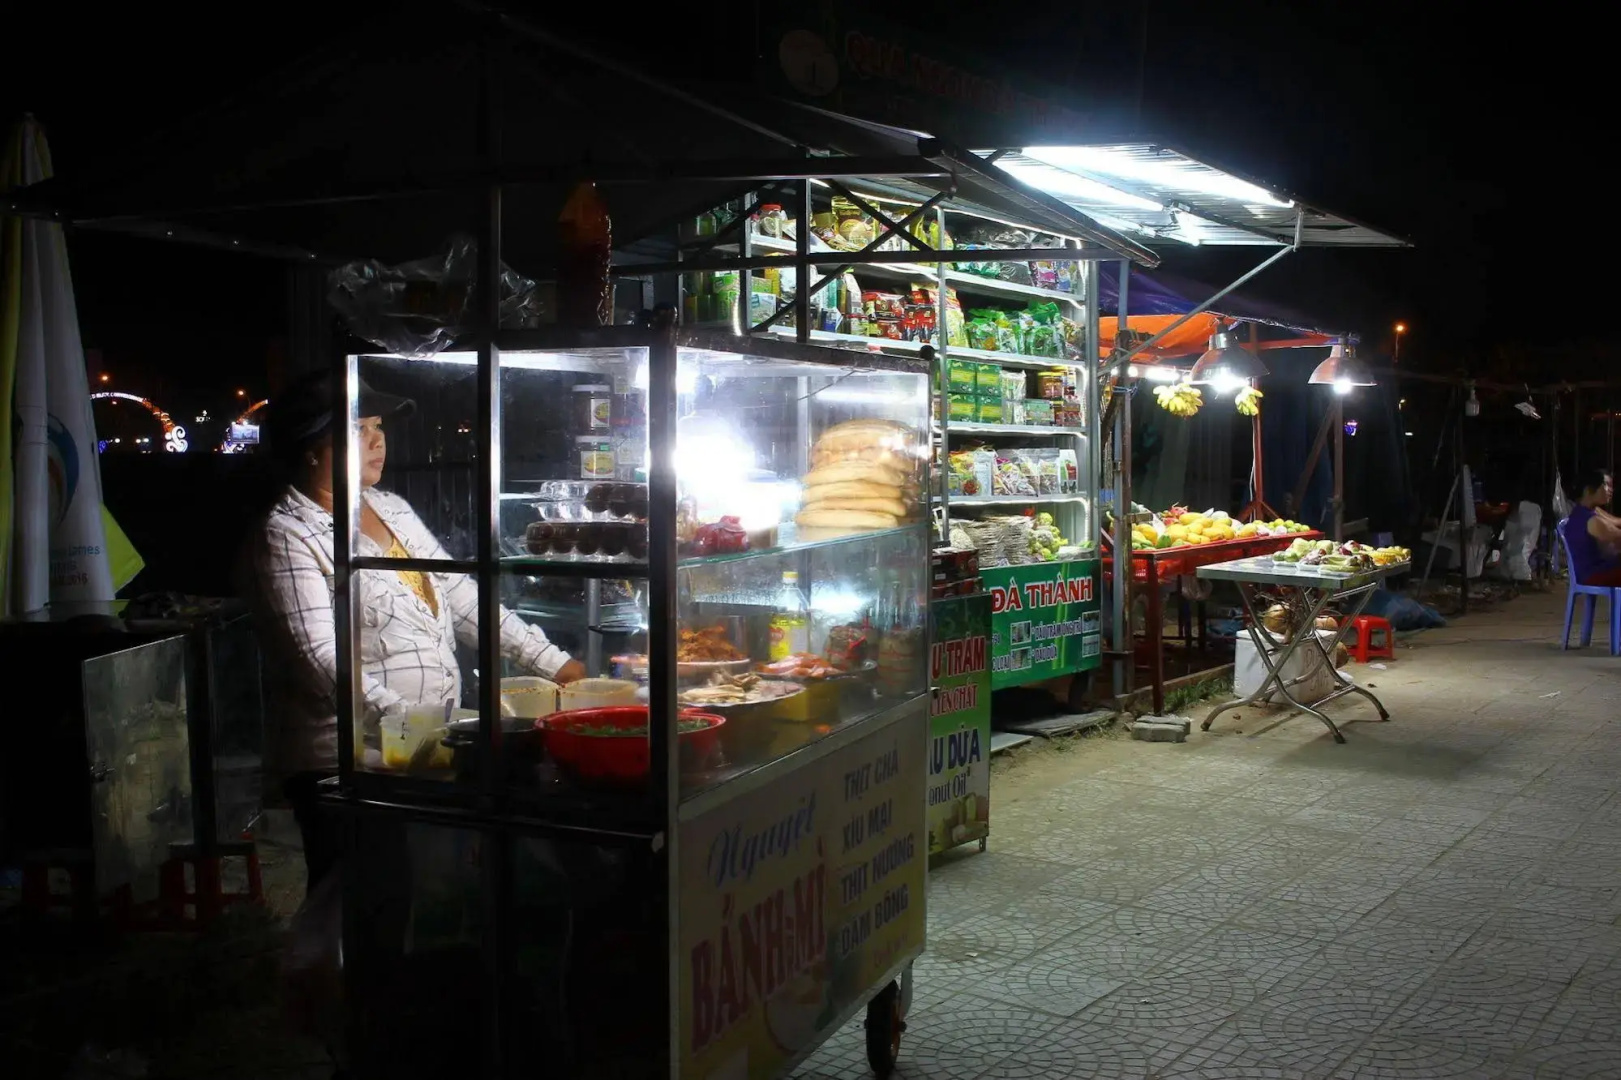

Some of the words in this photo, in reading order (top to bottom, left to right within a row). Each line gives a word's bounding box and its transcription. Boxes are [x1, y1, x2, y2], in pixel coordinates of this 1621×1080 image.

[990, 577, 1023, 613] ĐÀ
[1024, 572, 1092, 609] THÀNH
[948, 724, 981, 769] DỪA
